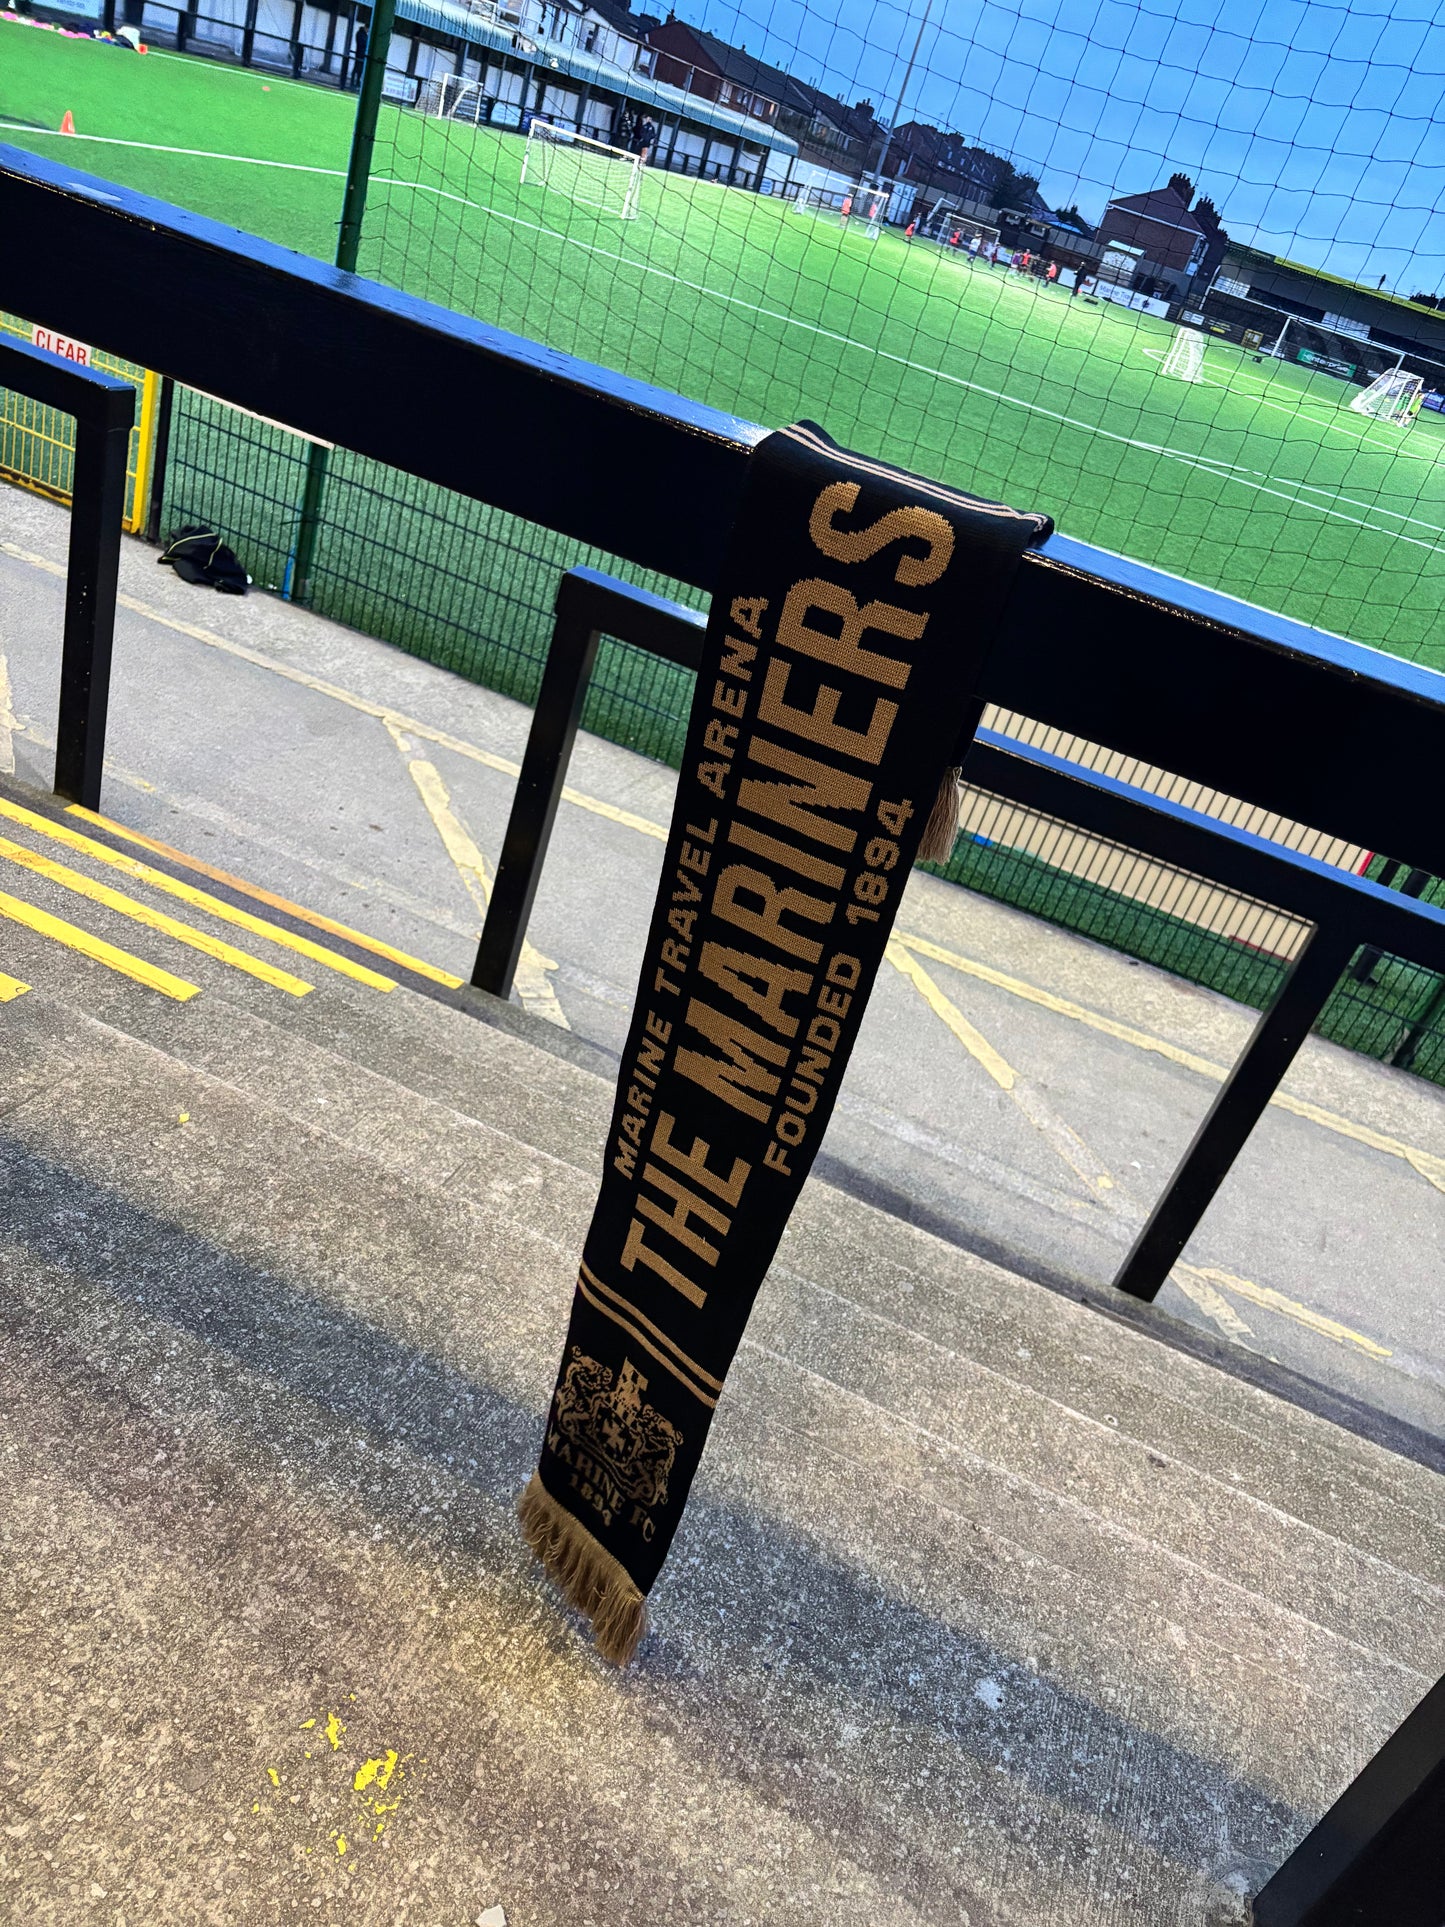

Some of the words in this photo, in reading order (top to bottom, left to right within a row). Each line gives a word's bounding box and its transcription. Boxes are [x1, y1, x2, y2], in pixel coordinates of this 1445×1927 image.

[36, 330, 87, 366] CLEAR
[613, 1010, 673, 1181] MARINE
[654, 817, 718, 997] TRAVEL
[697, 597, 769, 799] ARENA
[673, 481, 956, 1124] MARINERS
[763, 953, 862, 1176] FOUNDED
[846, 799, 914, 925] 1894
[620, 1110, 753, 1309] THE
[628, 1504, 656, 1542] FC
